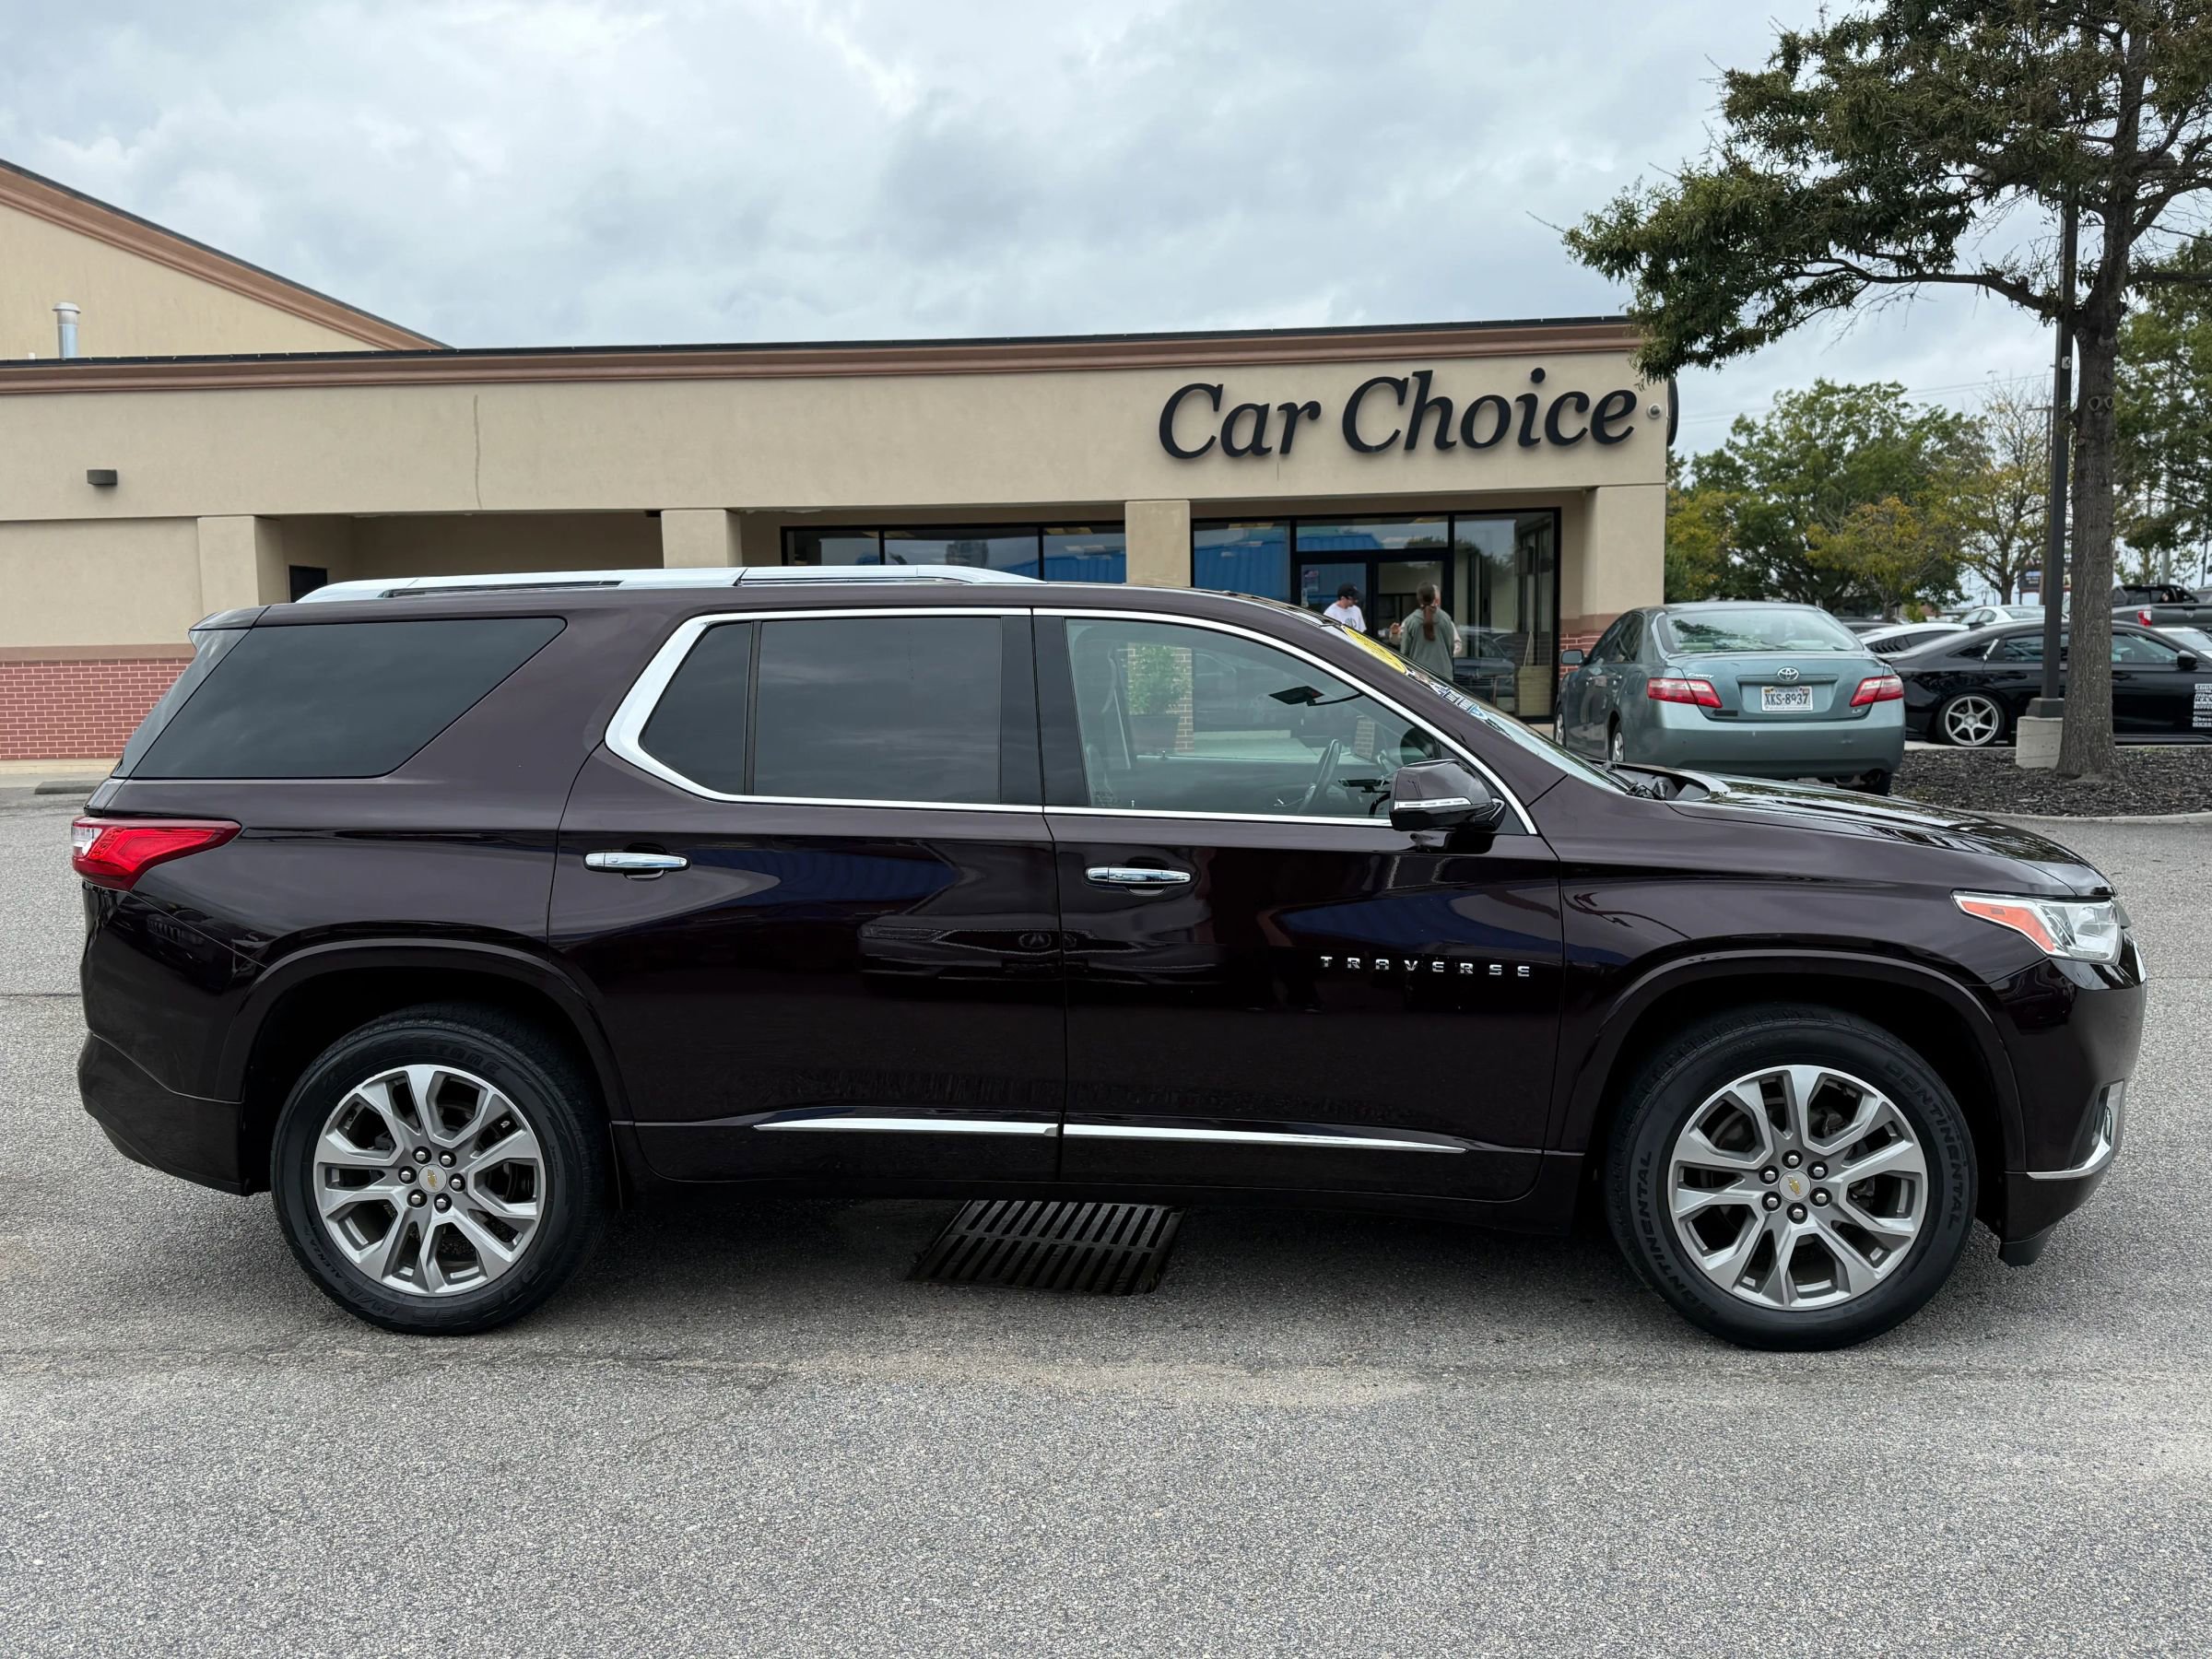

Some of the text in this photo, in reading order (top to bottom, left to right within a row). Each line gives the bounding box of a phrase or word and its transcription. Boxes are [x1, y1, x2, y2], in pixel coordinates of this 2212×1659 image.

[1159, 367, 1638, 459] Car Choice
[1764, 692, 1809, 706] XKS-8937
[1320, 955, 1530, 977] TRAVERSE
[1886, 1064, 1963, 1230] CONTINENTAL
[1637, 1150, 1718, 1314] CONTINENTAL
